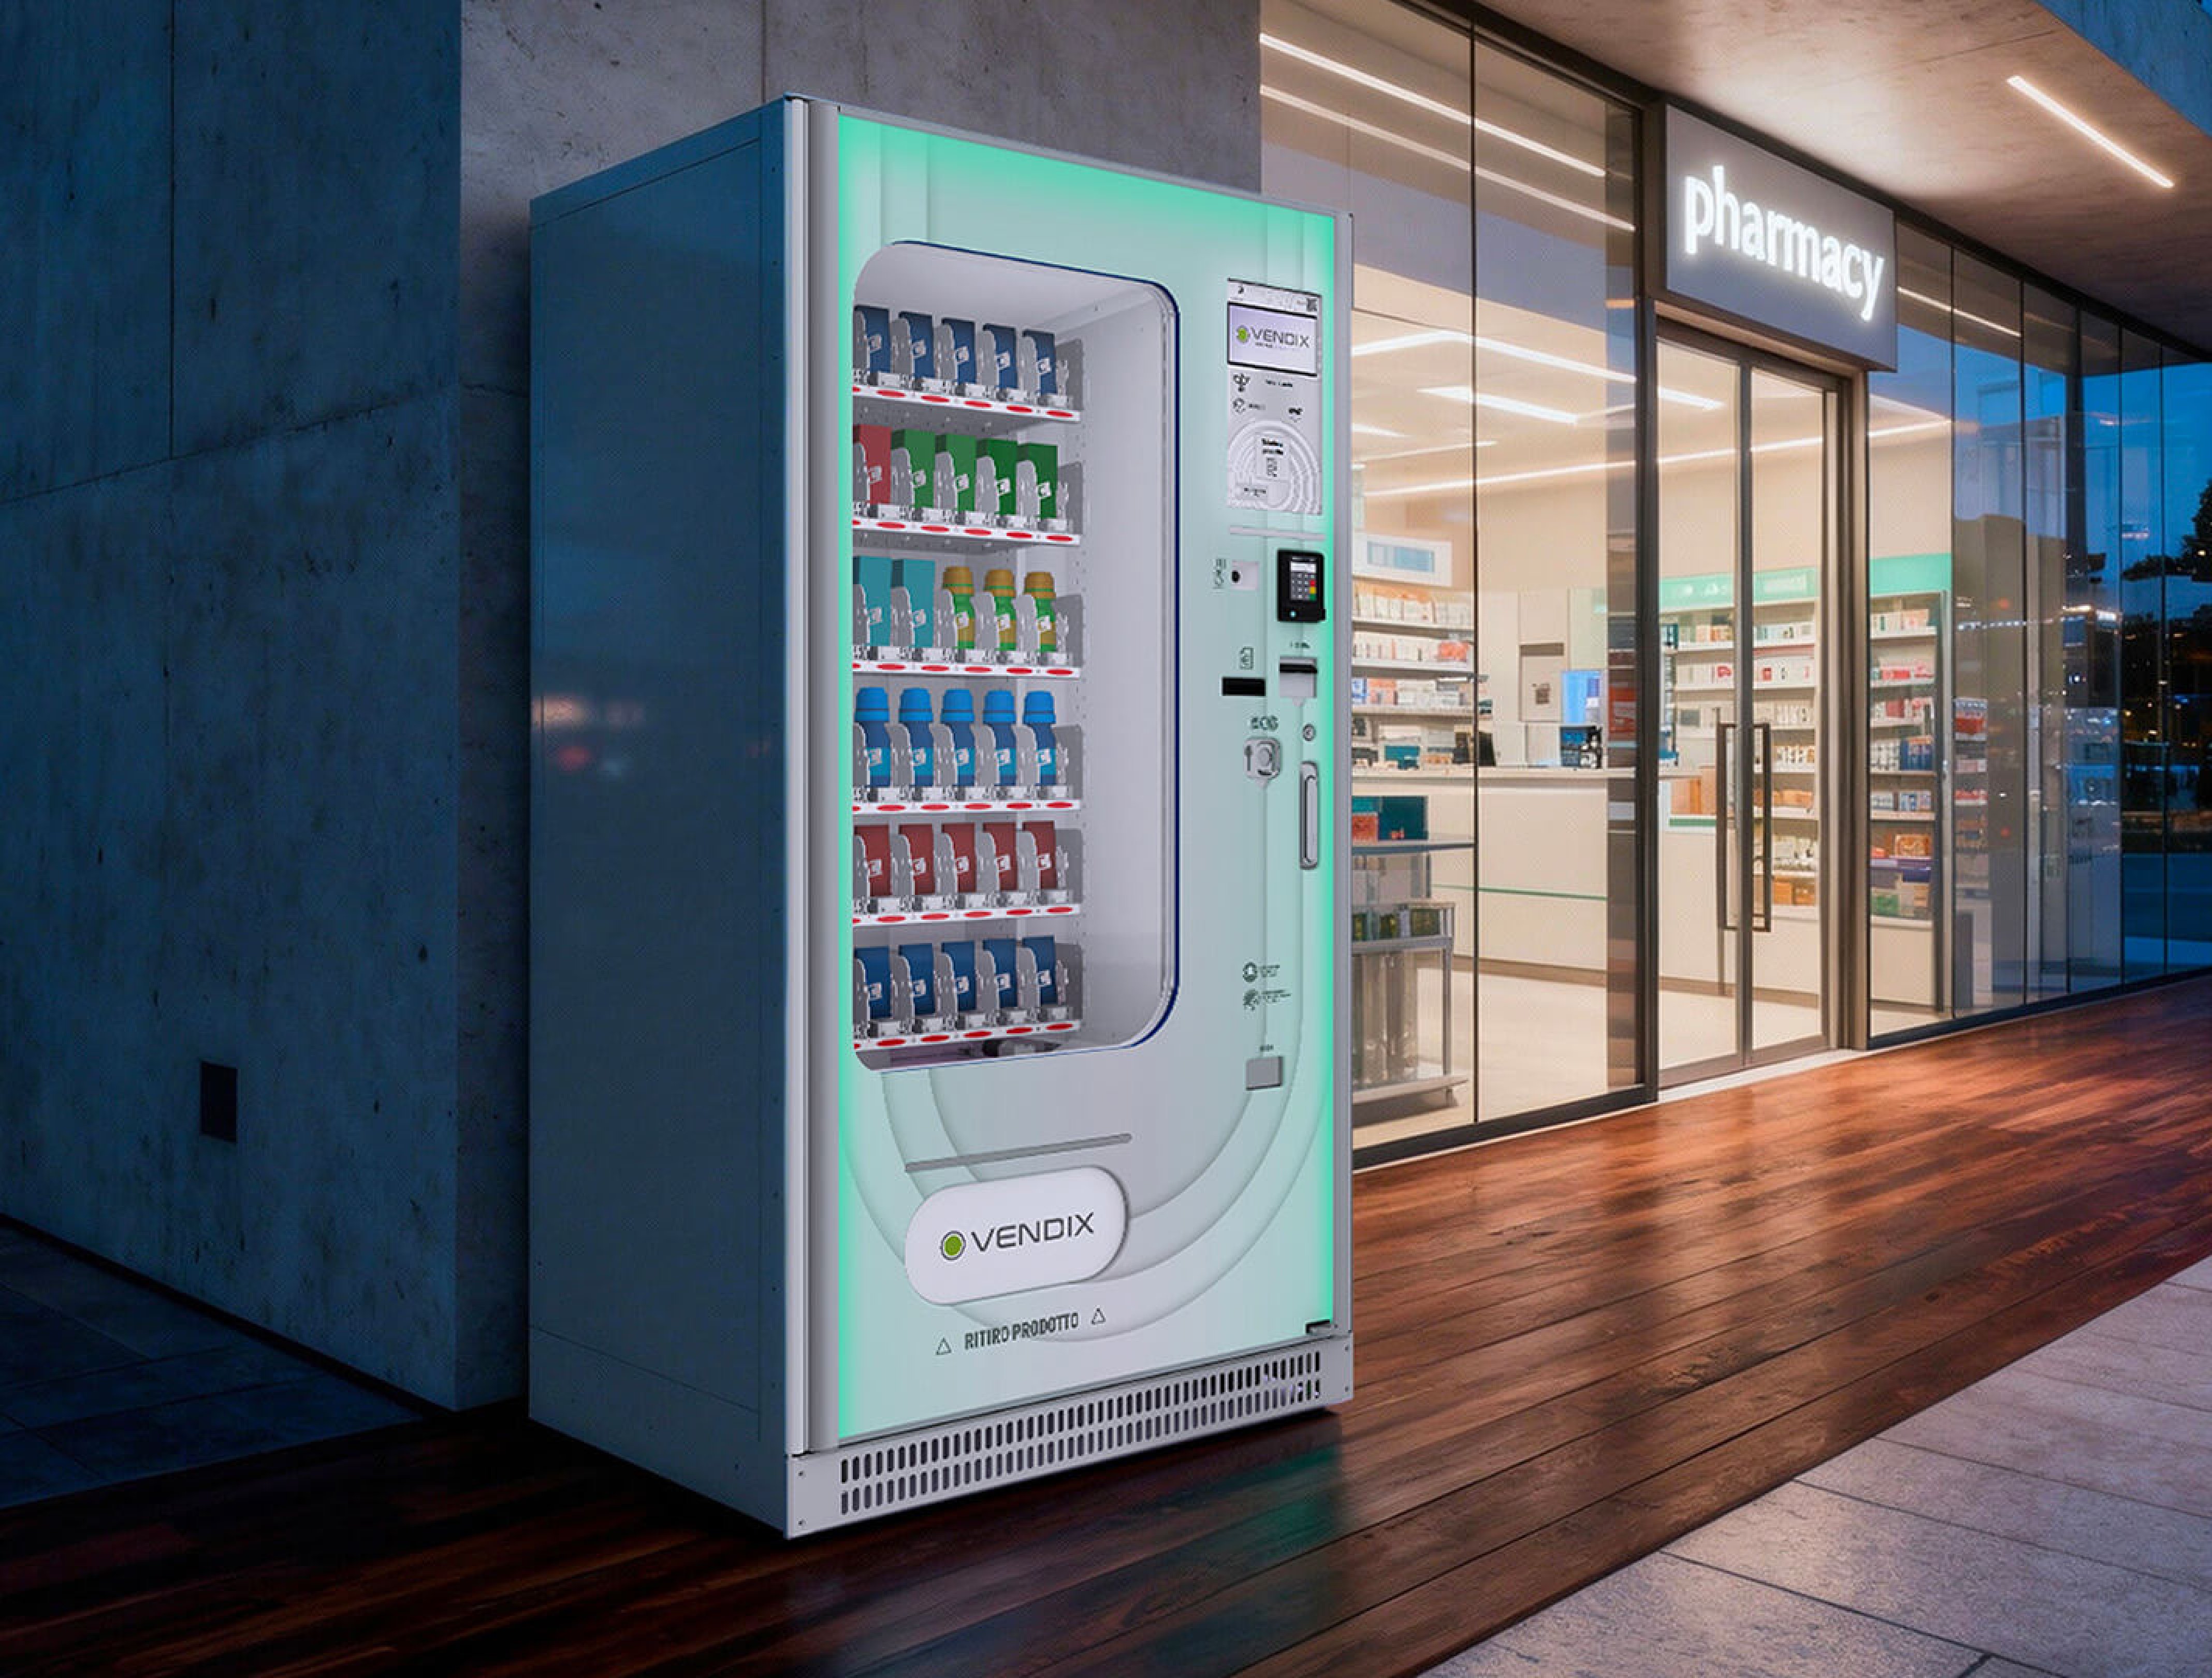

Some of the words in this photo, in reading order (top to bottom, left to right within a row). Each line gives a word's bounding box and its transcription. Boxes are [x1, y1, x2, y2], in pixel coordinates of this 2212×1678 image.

[1685, 165, 1885, 322] pharmacy
[1250, 326, 1309, 348] VENDIX
[971, 1211, 1094, 1252] VENDIX
[965, 1325, 1008, 1350] RITIRO
[1012, 1312, 1078, 1341] PRODOTTO
